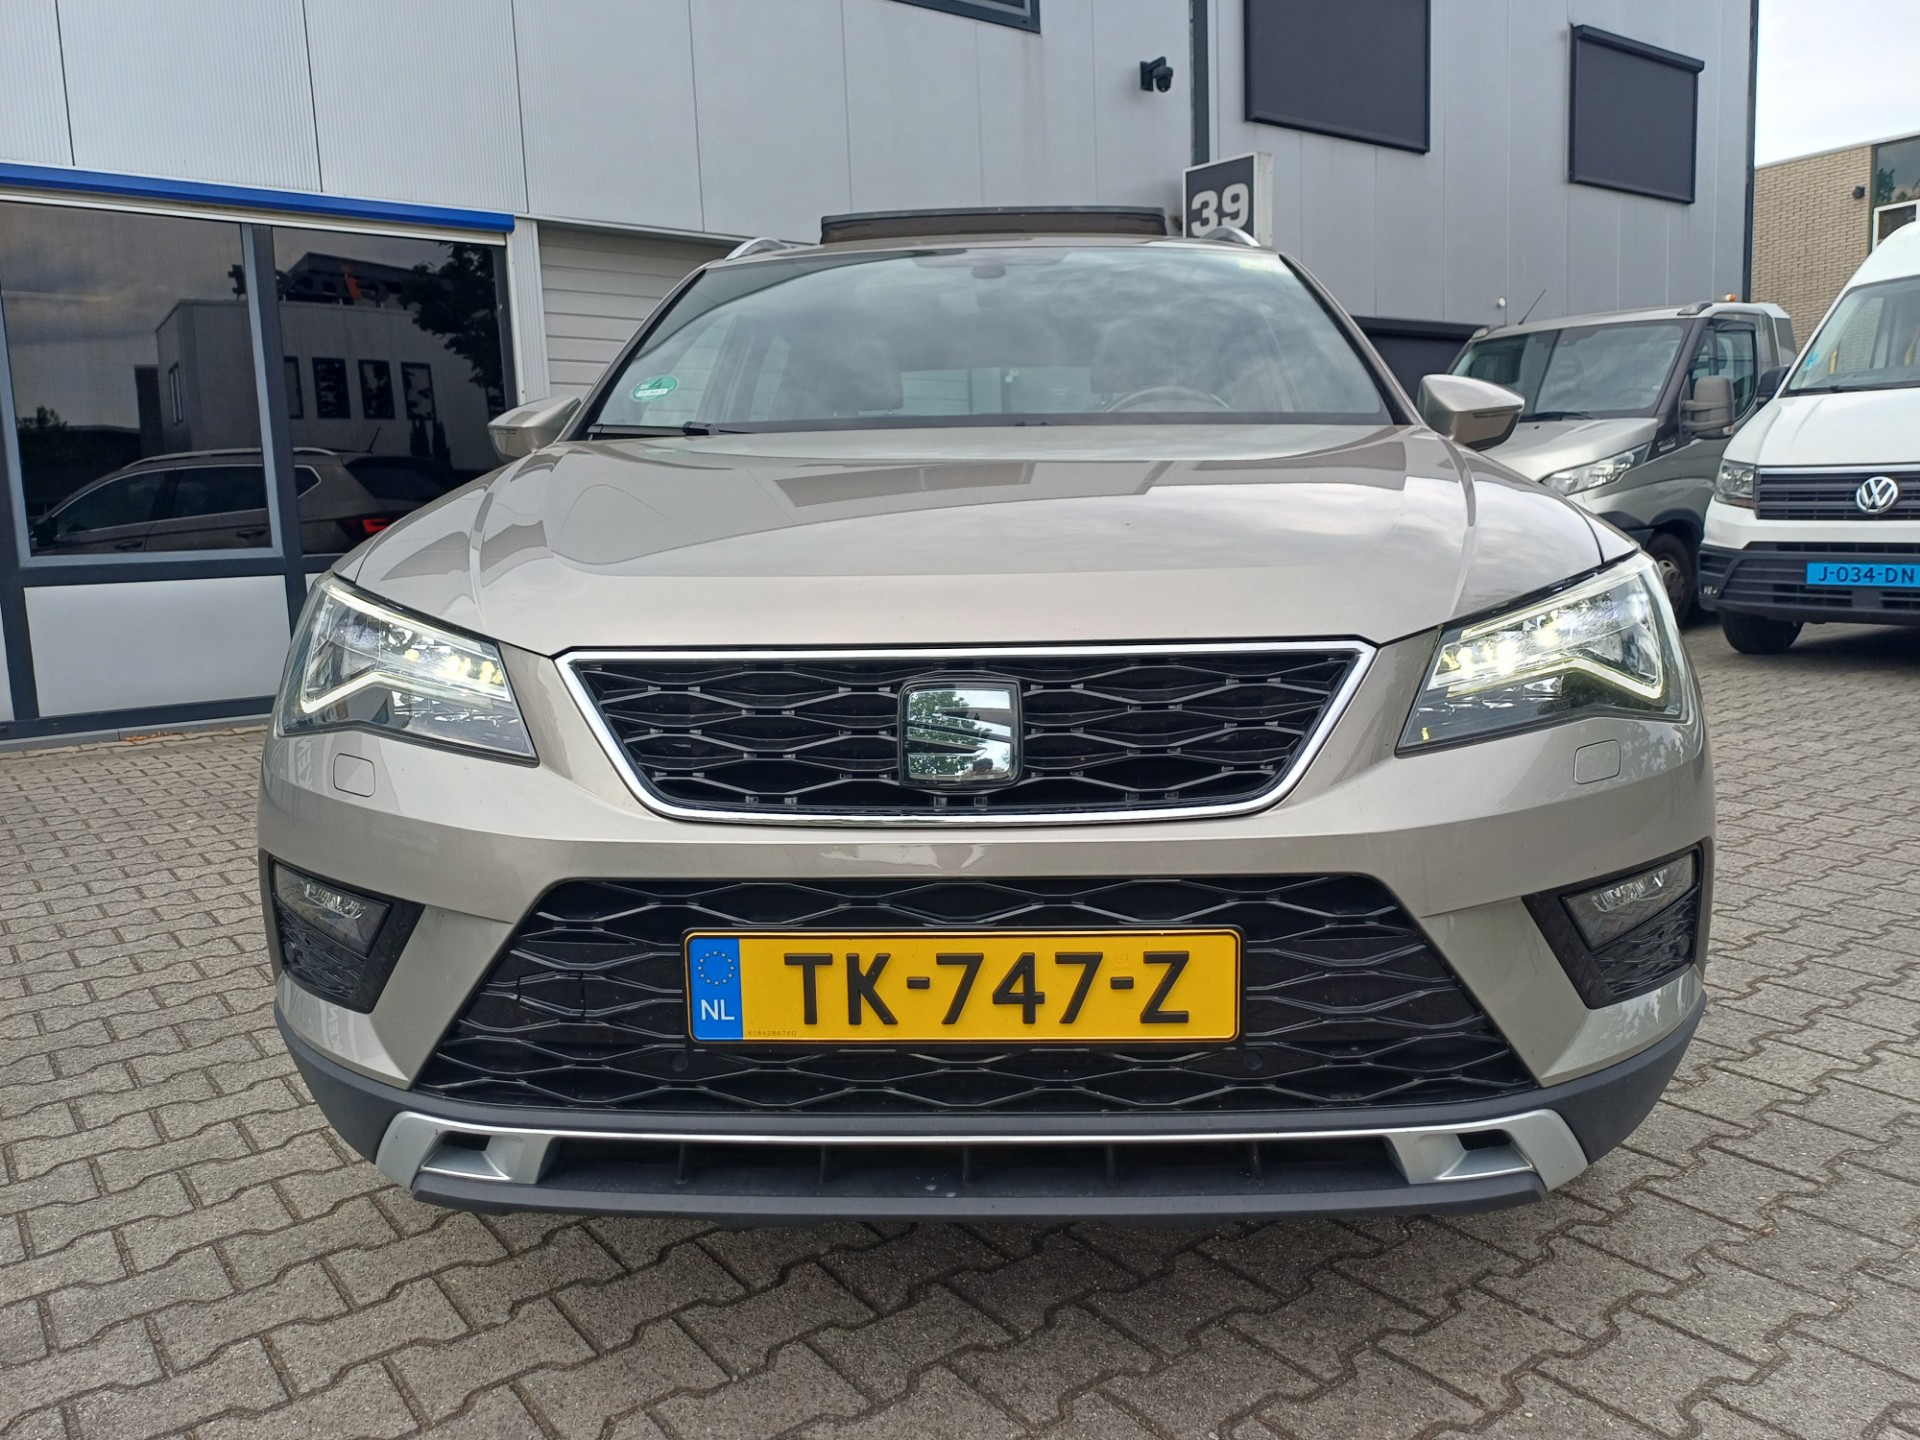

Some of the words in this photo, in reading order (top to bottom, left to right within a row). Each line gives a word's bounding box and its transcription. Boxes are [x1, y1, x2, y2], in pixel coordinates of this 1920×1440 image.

[1190, 182, 1249, 238] 39
[1818, 566, 1915, 584] J-034-DN
[784, 952, 1190, 1026] TK-747-Z
[701, 1001, 735, 1021] NL
